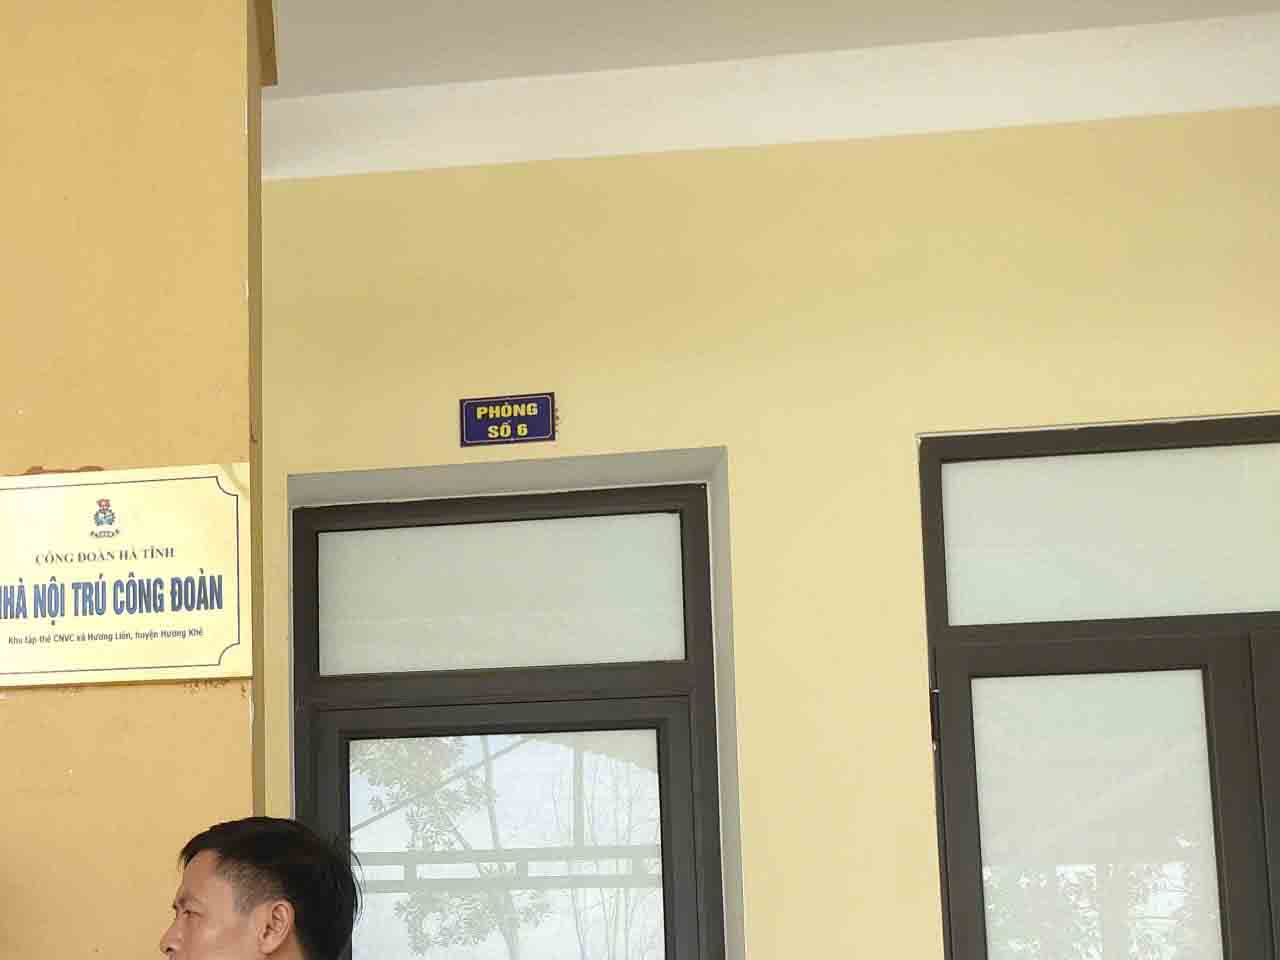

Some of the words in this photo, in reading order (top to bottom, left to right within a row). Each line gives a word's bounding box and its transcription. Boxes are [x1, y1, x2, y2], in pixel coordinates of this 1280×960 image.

[476, 401, 538, 419] PHÒNG
[487, 420, 512, 438] SỐ
[517, 423, 528, 437] 6
[35, 549, 74, 564] CÔNG
[78, 547, 115, 562] ĐOÀN
[119, 545, 138, 561] HÀ
[33, 576, 66, 626] NỘI
[71, 573, 107, 617] TRÚ
[113, 571, 165, 615] CÔNG
[170, 568, 224, 612] ĐOÀN
[53, 633, 75, 643] CNVC
